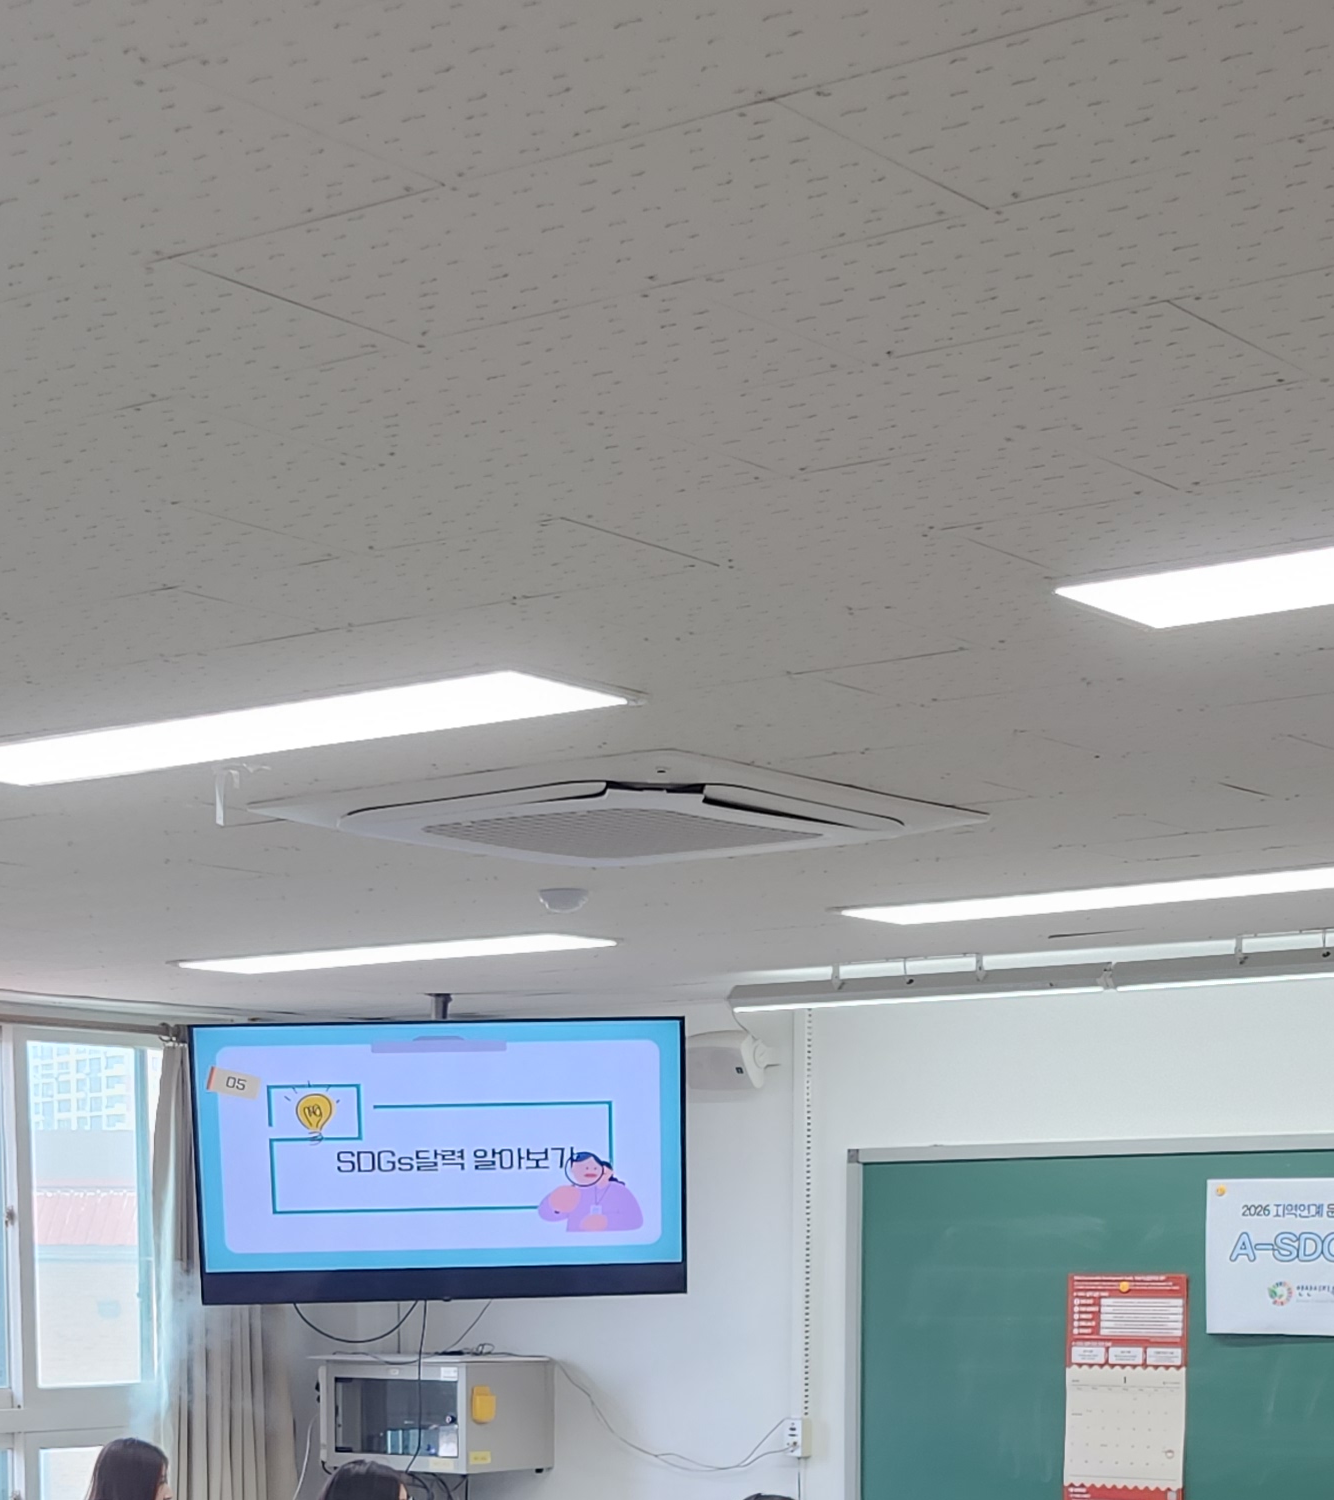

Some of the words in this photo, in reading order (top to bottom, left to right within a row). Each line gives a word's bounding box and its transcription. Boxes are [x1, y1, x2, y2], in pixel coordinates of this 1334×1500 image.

[225, 1075, 247, 1092] 05
[336, 1148, 466, 1173] SDGs달력
[473, 1146, 576, 1171] 알아보기
[1241, 1204, 1270, 1217] 2026
